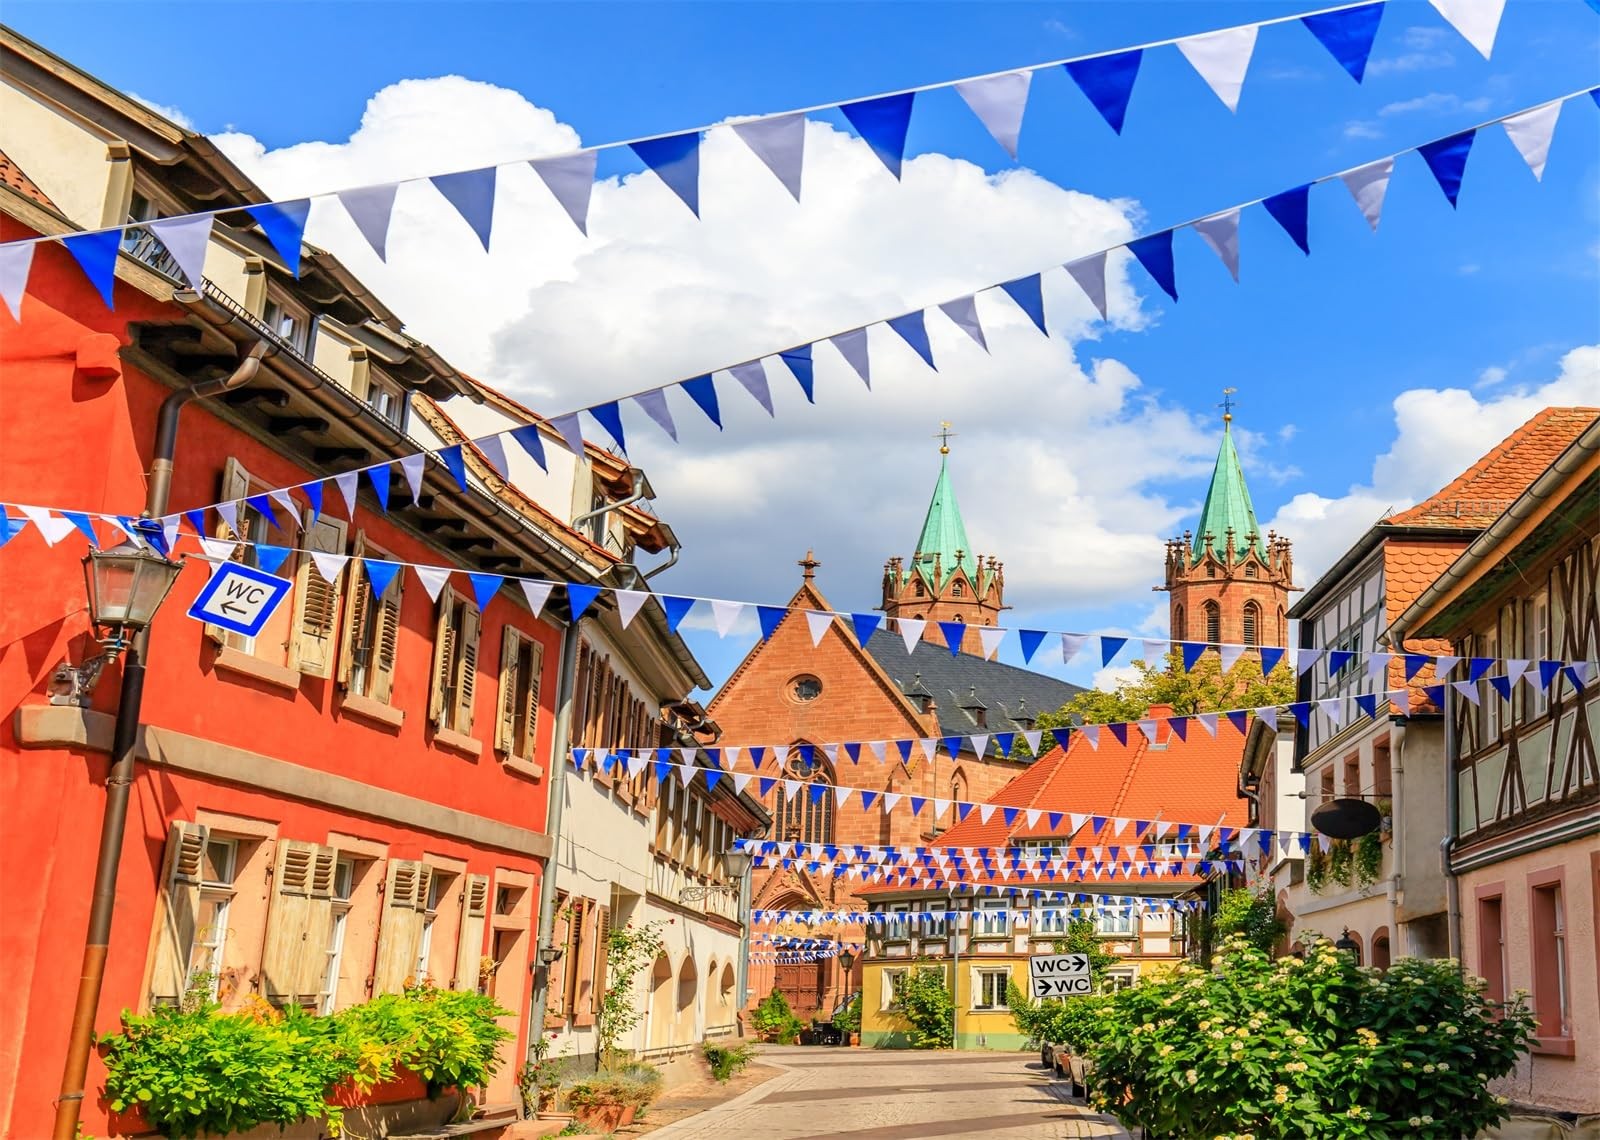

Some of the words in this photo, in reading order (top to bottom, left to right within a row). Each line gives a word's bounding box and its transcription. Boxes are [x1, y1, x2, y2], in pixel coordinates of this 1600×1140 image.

[226, 579, 265, 604] WC
[1036, 959, 1071, 973] WC
[1054, 978, 1089, 993] WC
